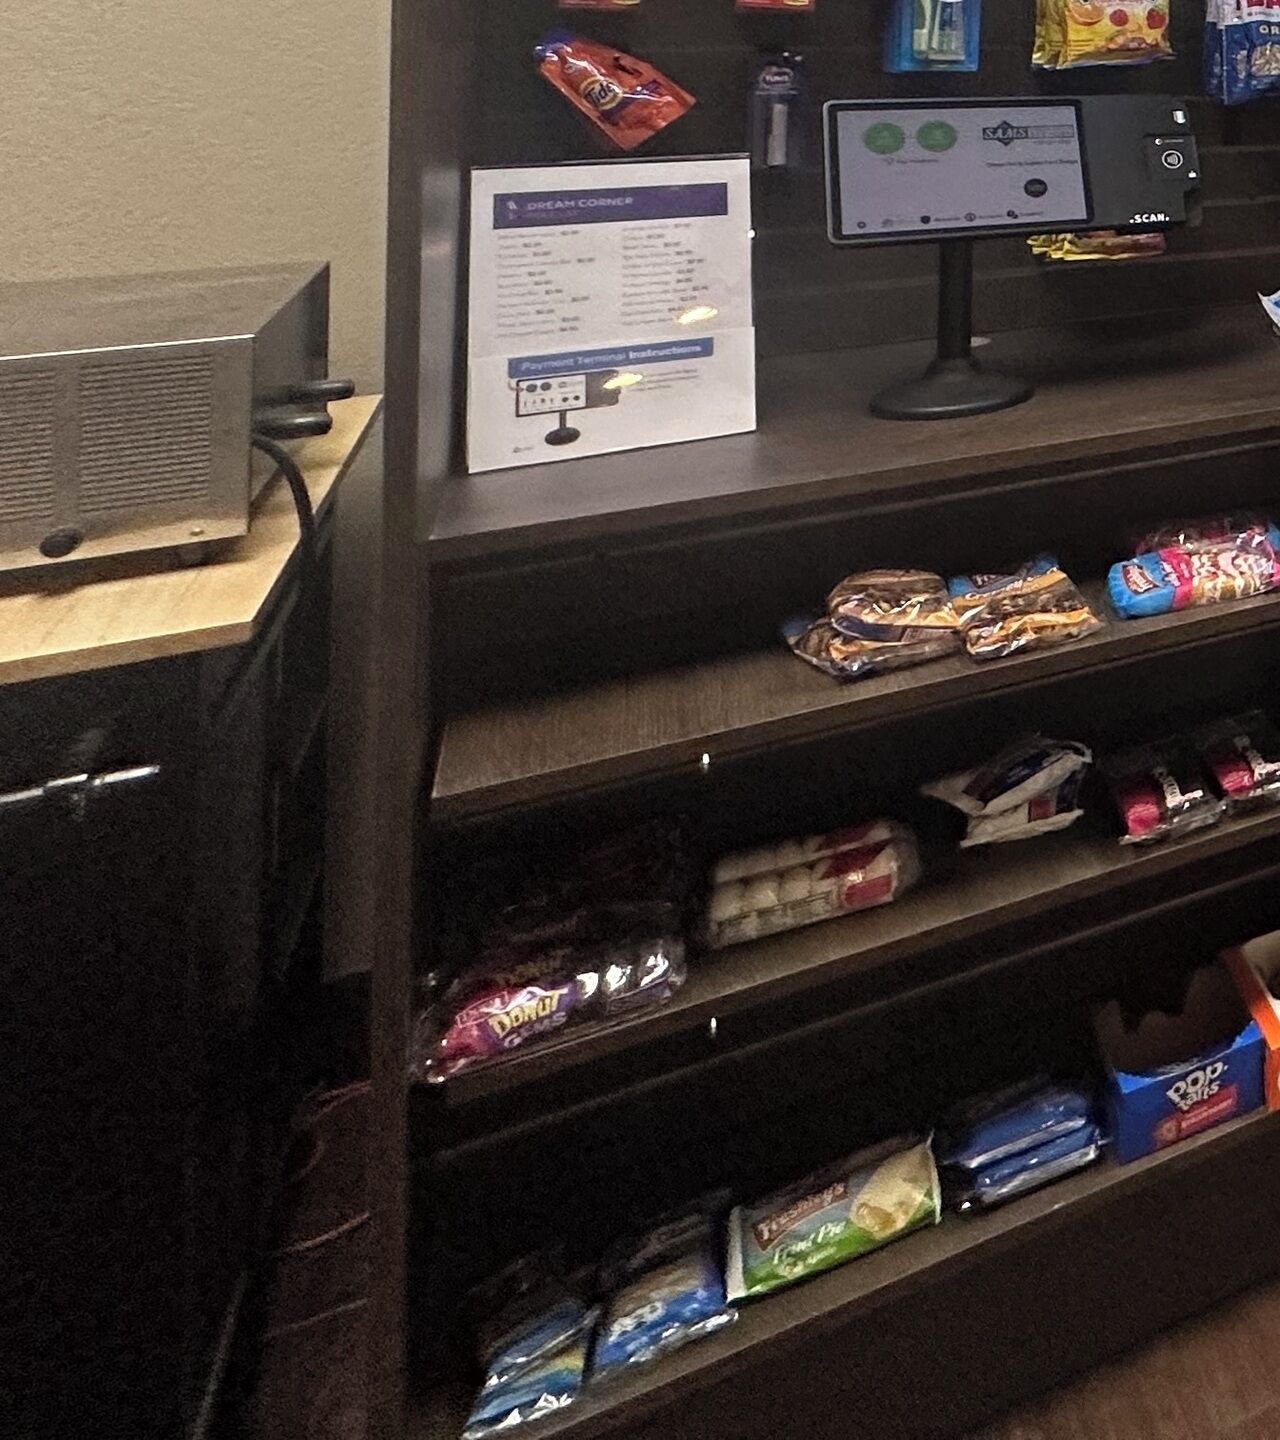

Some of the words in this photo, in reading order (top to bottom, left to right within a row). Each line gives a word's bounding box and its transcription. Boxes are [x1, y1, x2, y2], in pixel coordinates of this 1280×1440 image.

[527, 200, 576, 210] DREAM
[578, 196, 634, 208] CORNER
[1134, 213, 1165, 223] SCAN
[628, 344, 702, 360] Instructions
[490, 990, 563, 1037] DONUT
